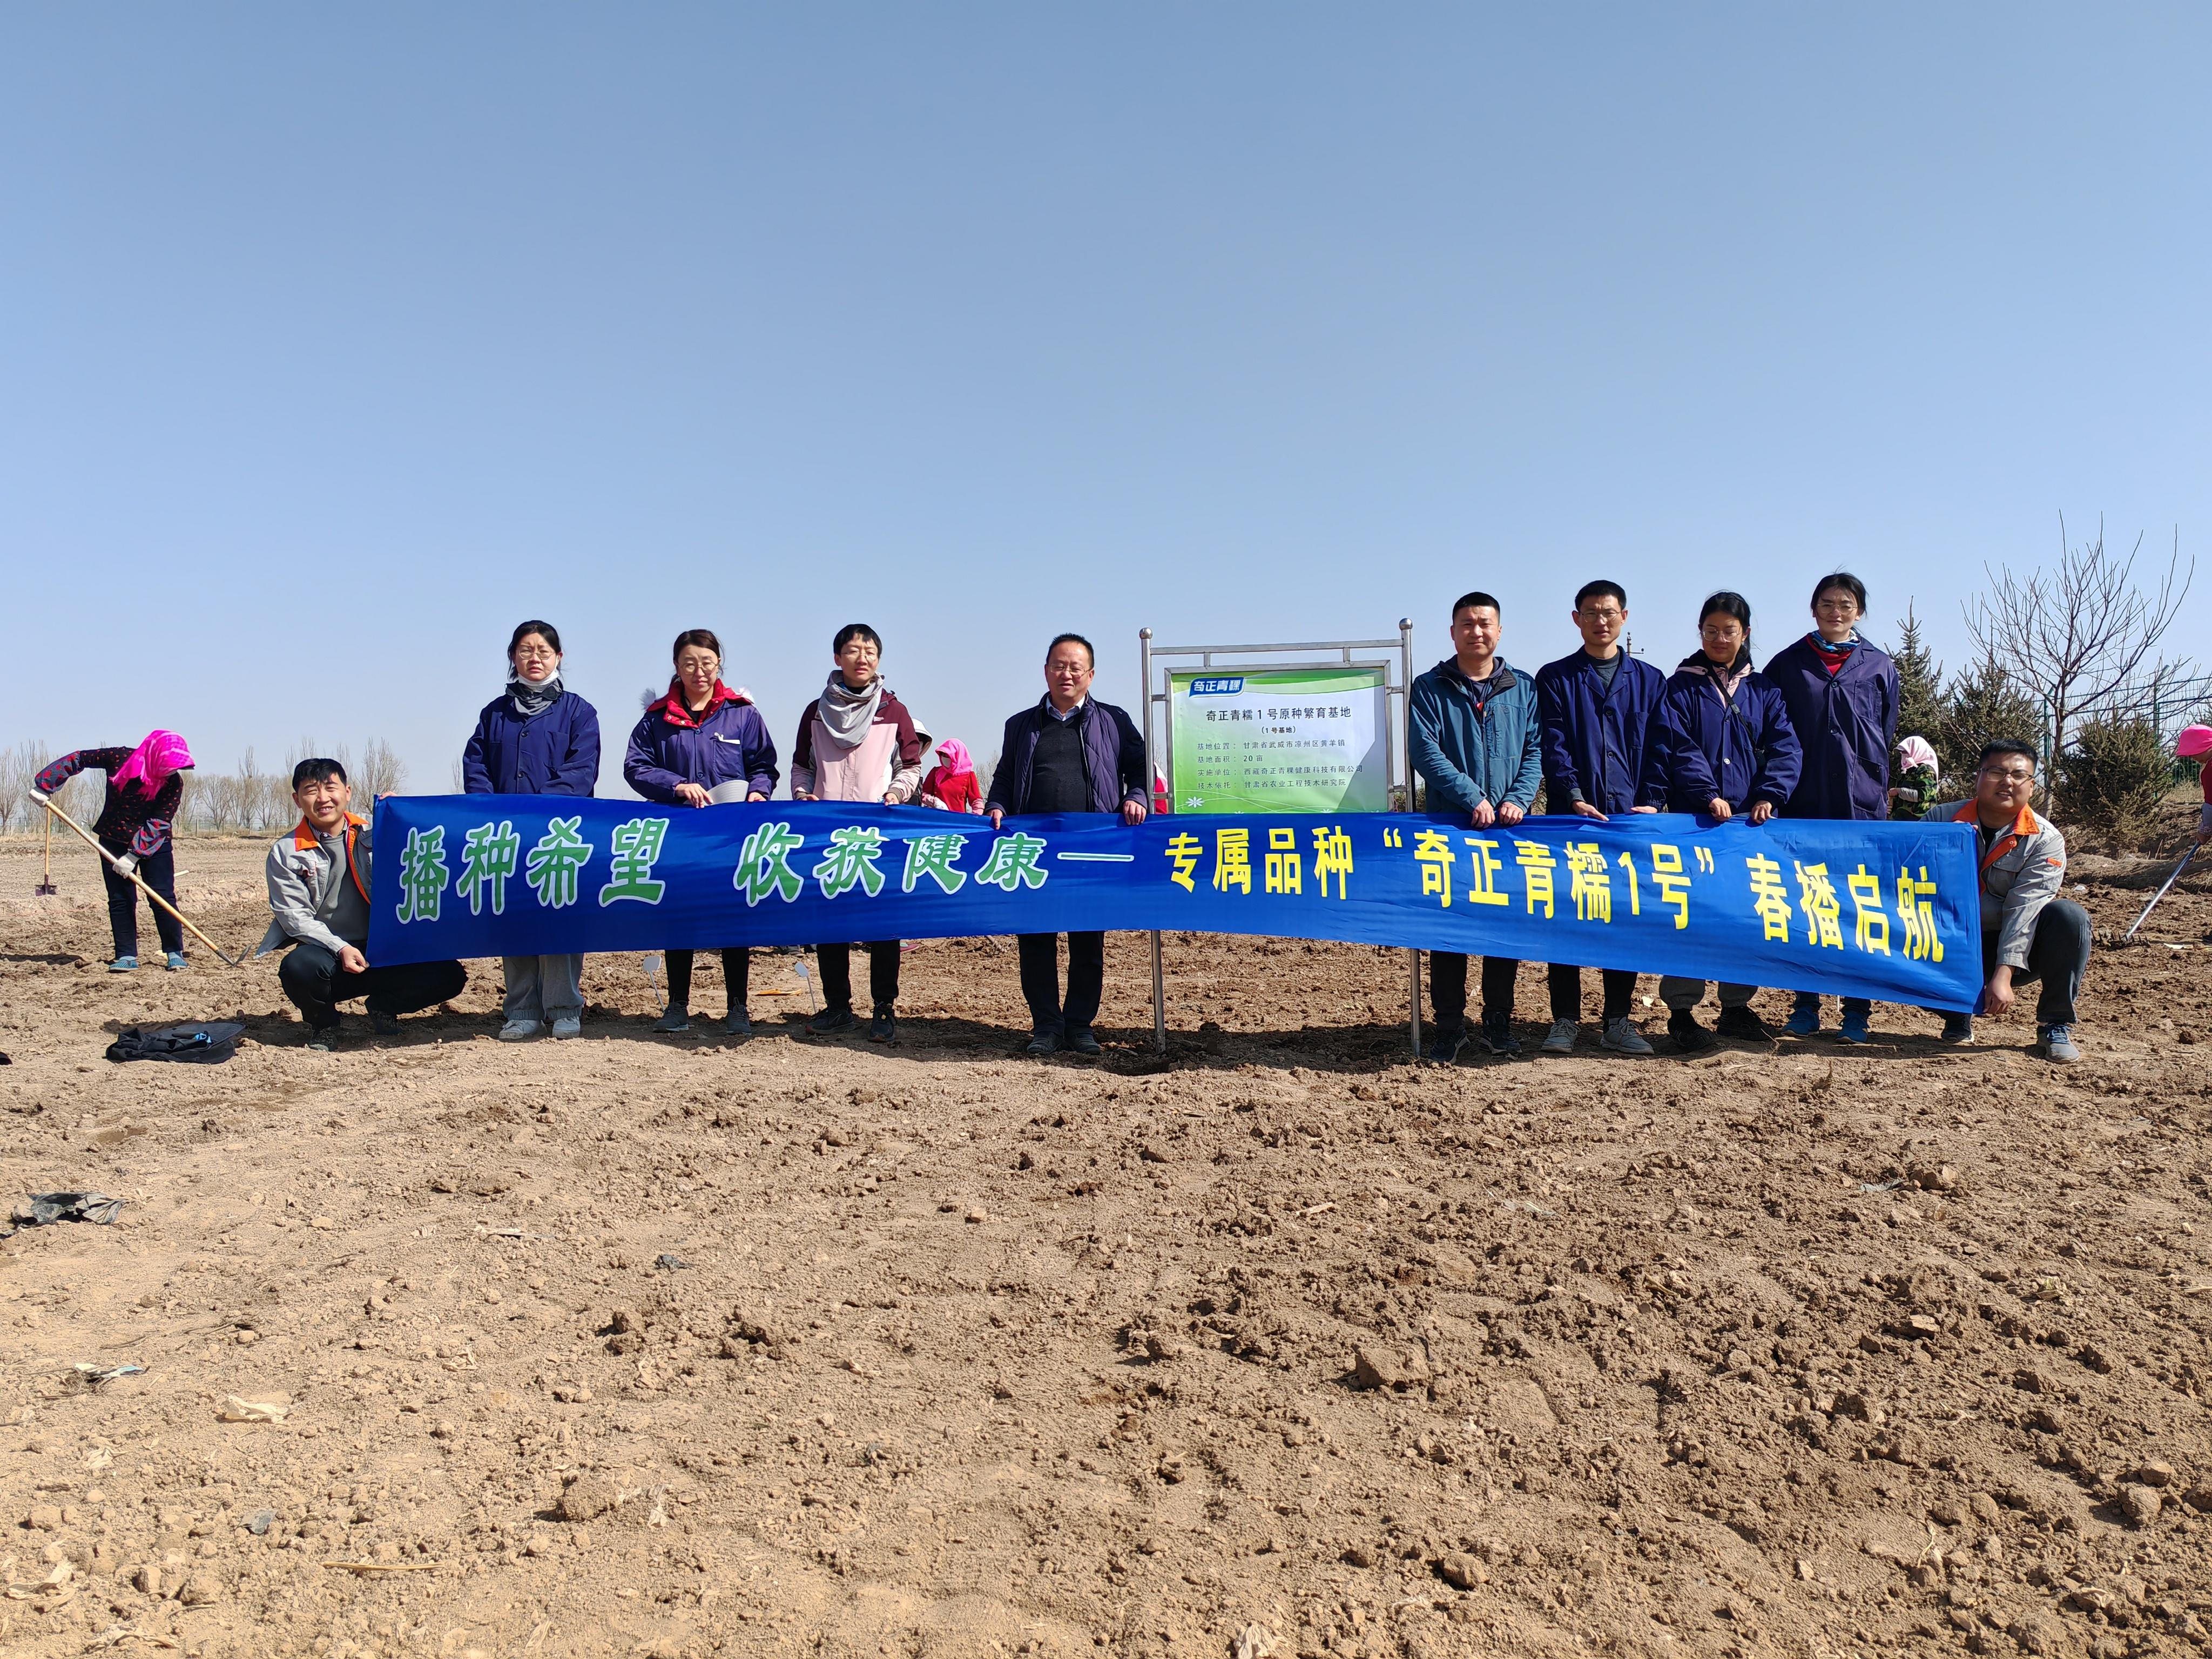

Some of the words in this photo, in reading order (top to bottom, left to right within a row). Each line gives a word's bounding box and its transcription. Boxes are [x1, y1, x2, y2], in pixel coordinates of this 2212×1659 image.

[1193, 679, 1241, 692] 奇正青稞
[396, 815, 670, 924] 播种希望
